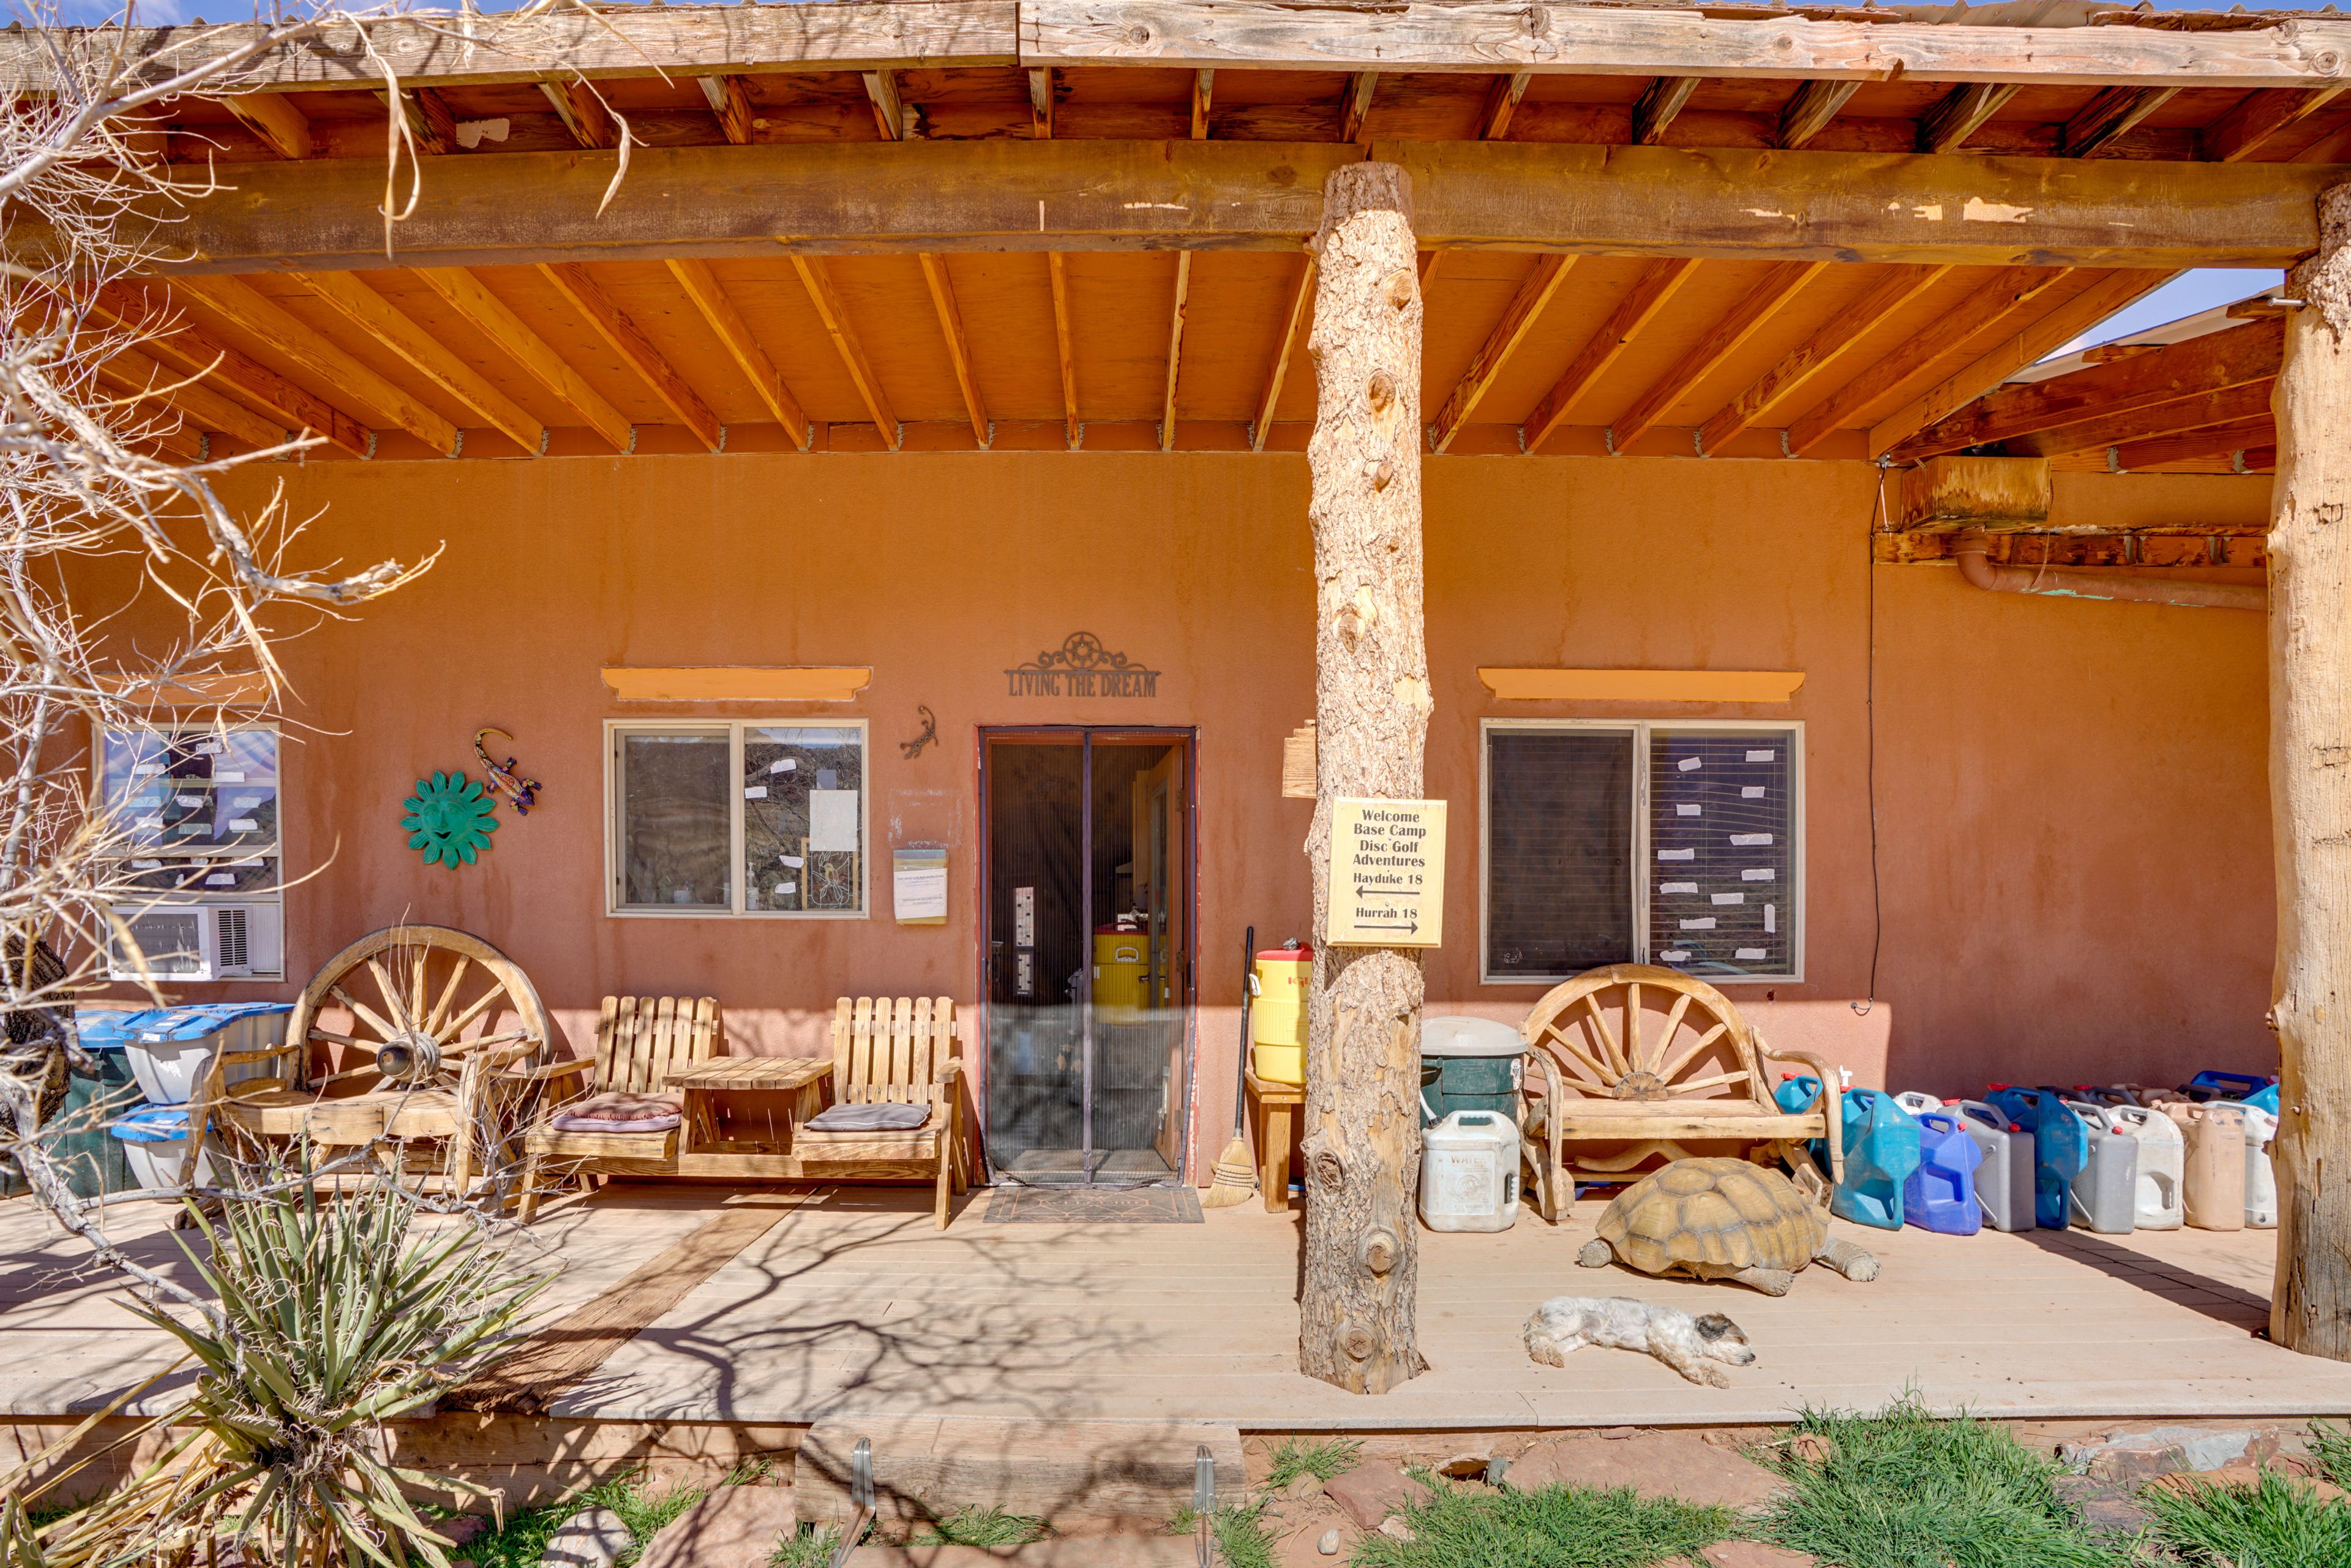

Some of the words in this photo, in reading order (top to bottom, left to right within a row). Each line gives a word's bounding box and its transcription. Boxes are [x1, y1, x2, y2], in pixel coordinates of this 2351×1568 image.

[1008, 672, 1060, 697] LIVING
[1065, 672, 1095, 697] THE
[1100, 672, 1157, 697] DREAM
[1362, 809, 1420, 822] Welcome
[1354, 823, 1385, 835] Base
[1389, 824, 1427, 839] Camp
[1360, 839, 1388, 852] Disc
[1392, 841, 1419, 852] Golf
[1352, 853, 1425, 867] Adventures
[1353, 872, 1403, 886] Hayduke
[1408, 874, 1423, 885] 18
[1355, 907, 1397, 918] Hurrah
[1403, 908, 1417, 918] 18
[1288, 977, 1313, 988] IGL
